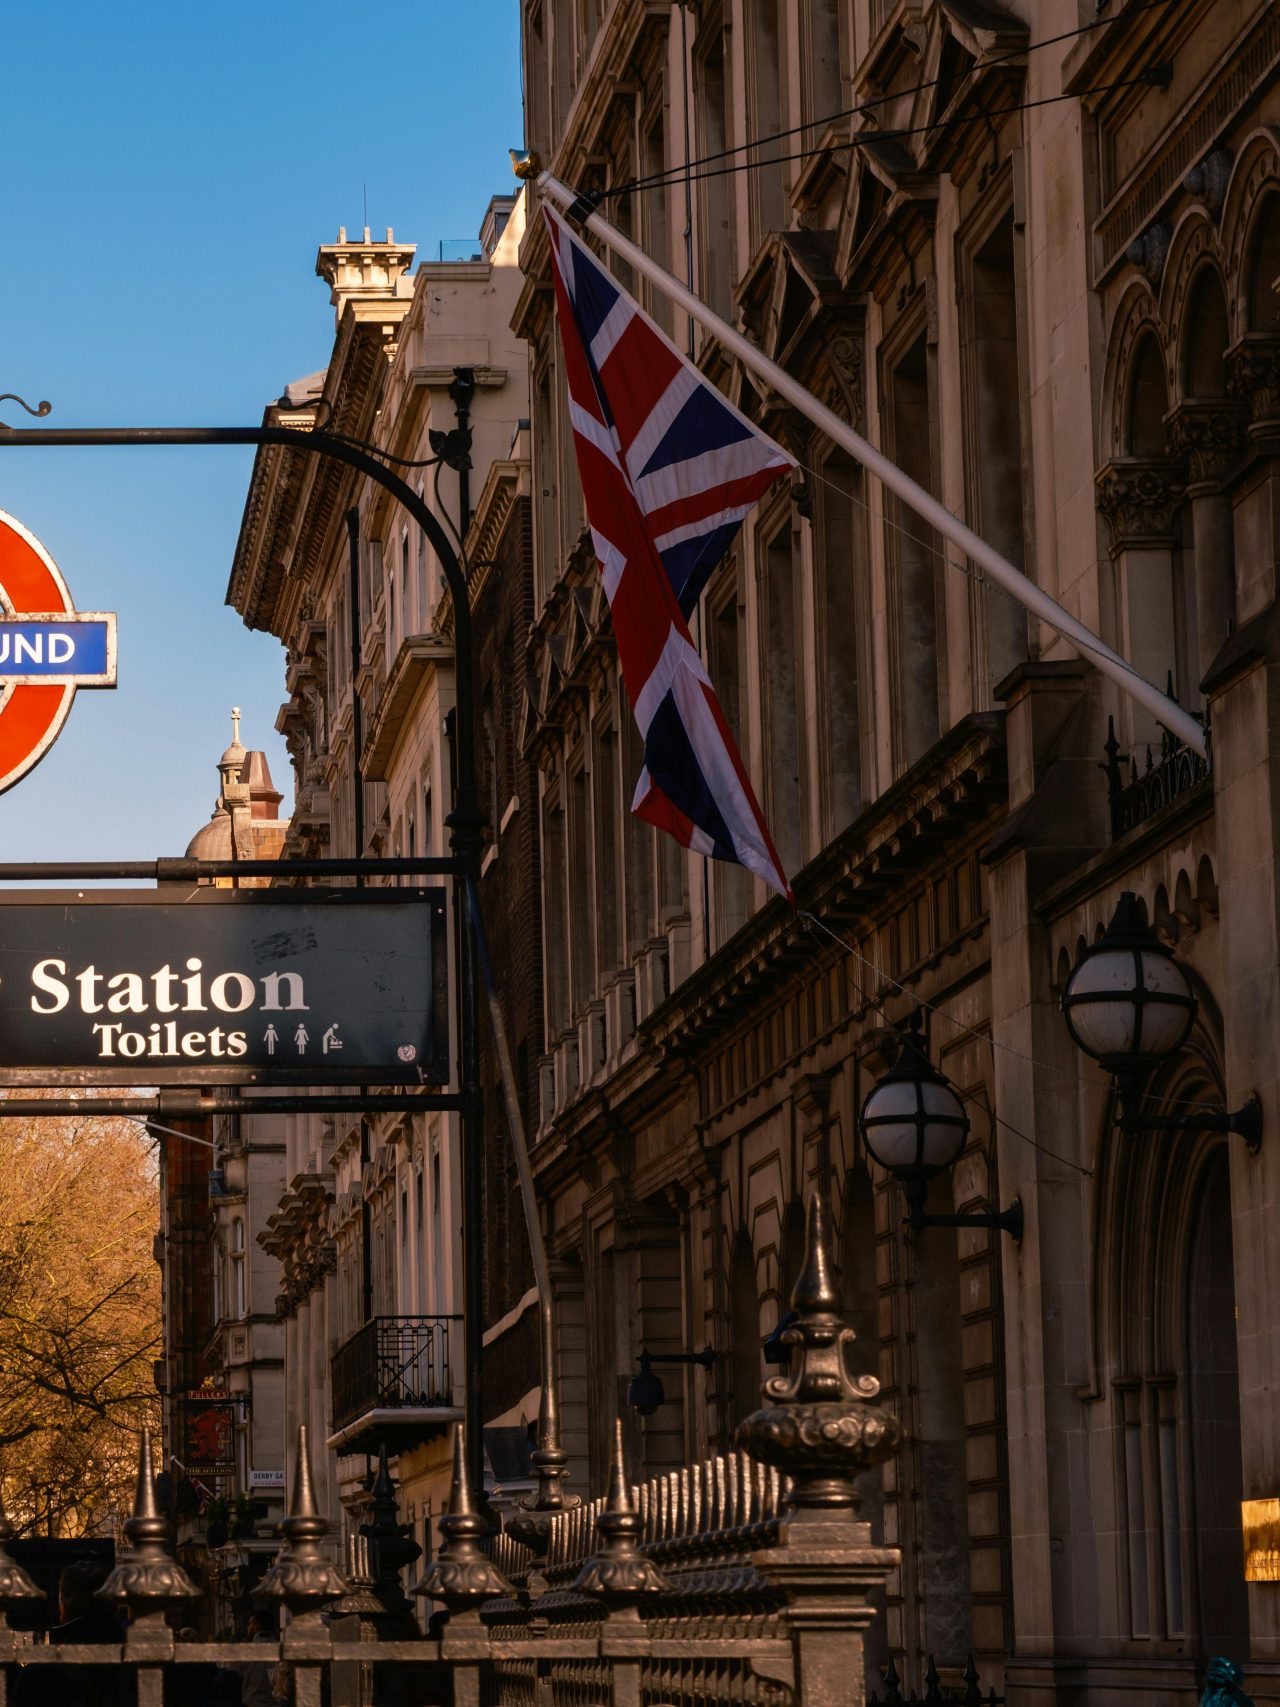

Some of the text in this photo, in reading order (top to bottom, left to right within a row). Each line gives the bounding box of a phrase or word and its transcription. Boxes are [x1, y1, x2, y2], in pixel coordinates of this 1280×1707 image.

[31, 957, 310, 1014] Station
[93, 1020, 248, 1057] Toilets
[253, 1472, 284, 1480] DERBY GA
